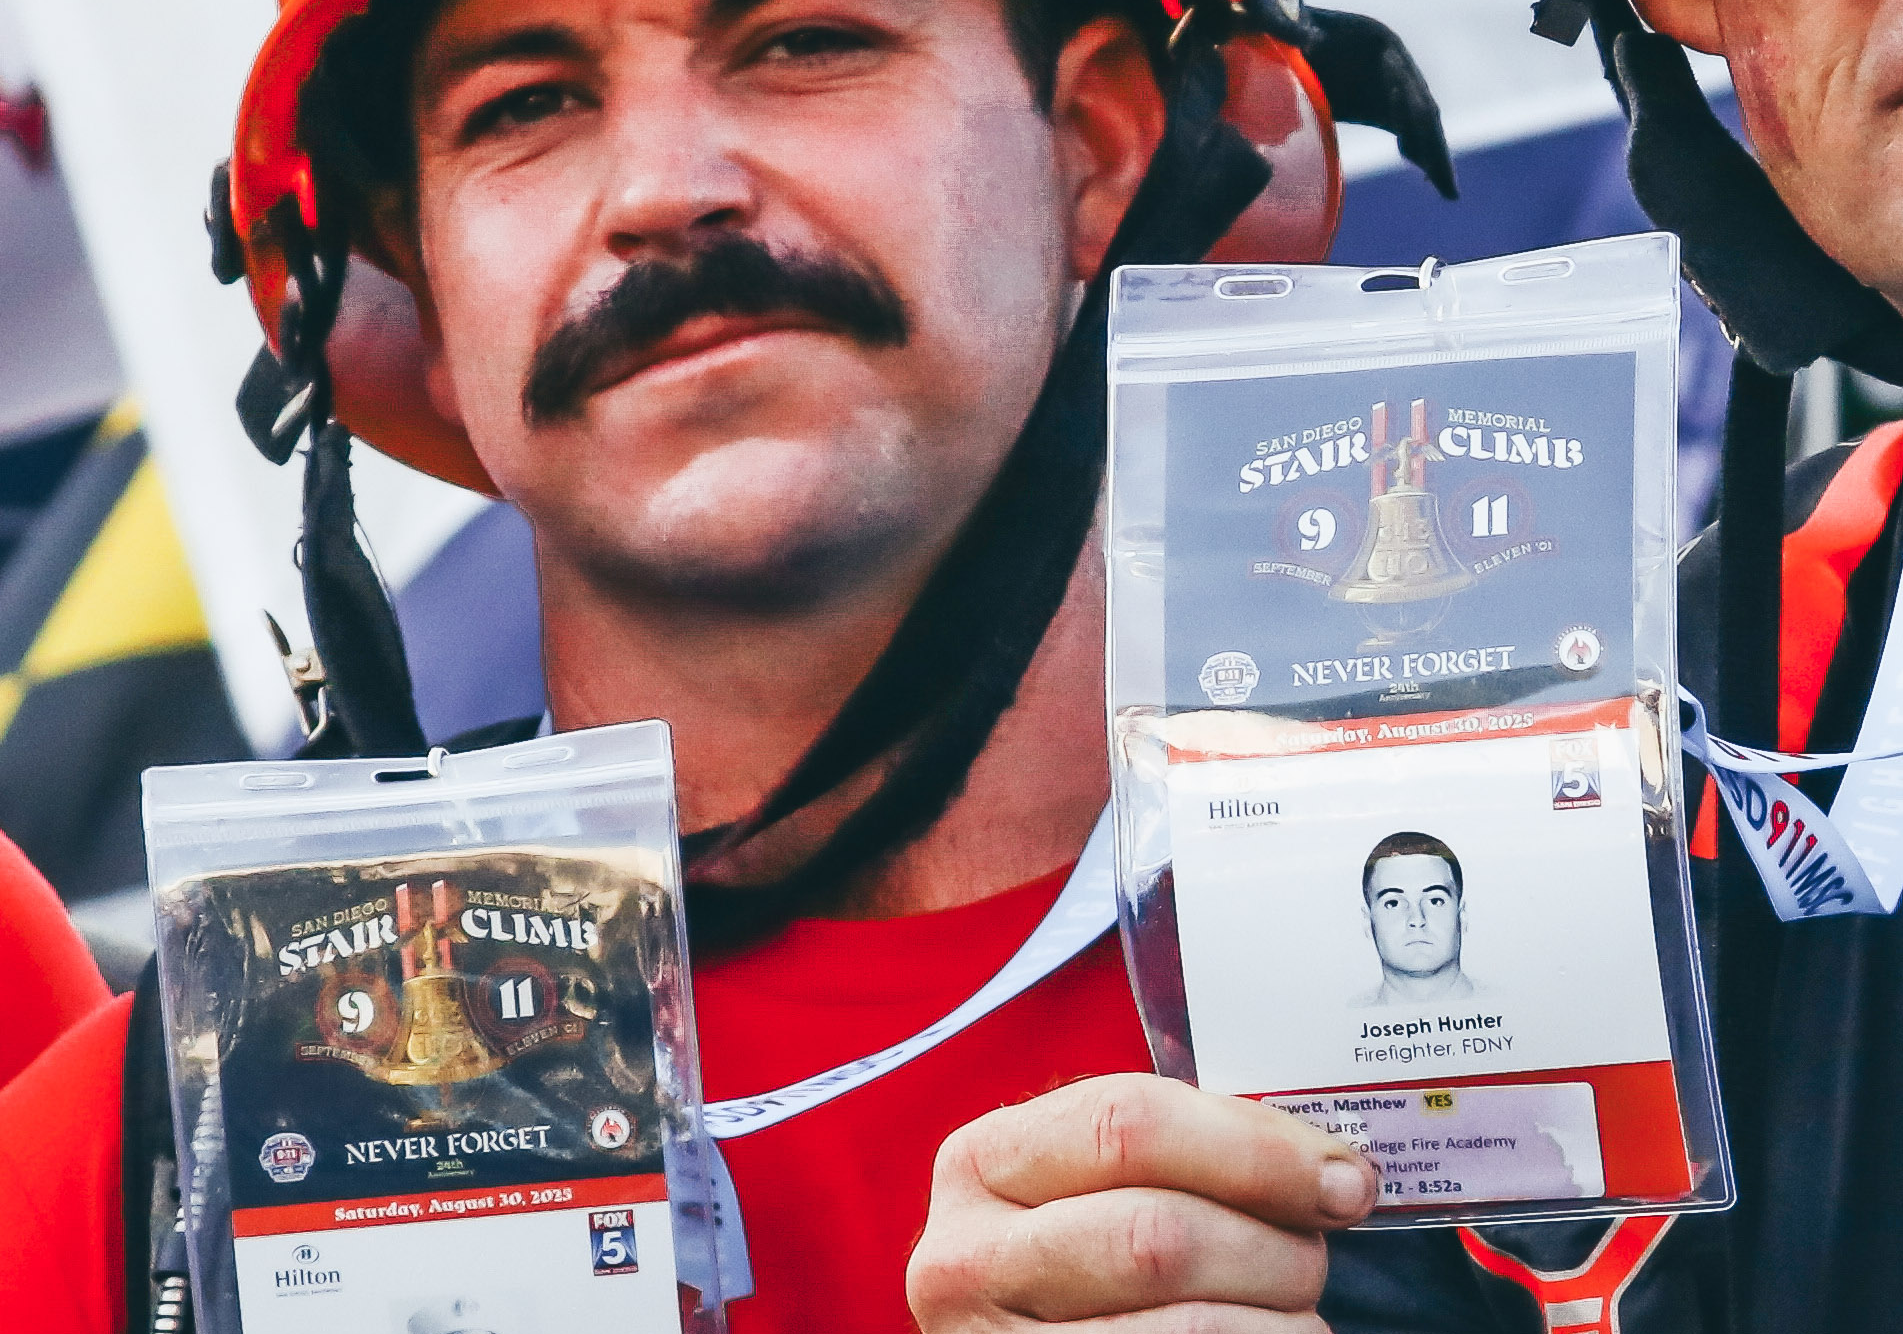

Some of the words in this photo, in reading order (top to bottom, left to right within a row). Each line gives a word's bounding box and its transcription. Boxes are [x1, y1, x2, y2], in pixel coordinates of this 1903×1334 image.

[1256, 434, 1297, 455] SAN
[1302, 416, 1363, 444] DIEGO
[1448, 408, 1552, 434] MEMORIAL
[1239, 431, 1371, 493] STAIR
[1438, 426, 1586, 469] CLIMB
[1297, 507, 1337, 551] 9
[1471, 494, 1509, 538] 11
[1252, 562, 1332, 587] SEPTEMBER
[1474, 542, 1532, 575] ELEVEN
[1291, 655, 1393, 688] NEVER
[1402, 645, 1516, 679] FORGET
[1276, 726, 1372, 751] Saturday,
[1377, 720, 1450, 742] August
[1487, 712, 1535, 731] 2025
[1561, 760, 1590, 798] 5
[1208, 796, 1281, 820] Hilton
[292, 917, 328, 938] SAN
[333, 898, 388, 926] DIEGO
[467, 889, 566, 913] MEMORI
[277, 914, 400, 977] STAIR
[461, 908, 598, 950] CLIMB
[337, 991, 375, 1035] 9
[499, 976, 535, 1019] 11
[1360, 1019, 1432, 1039] Joseph
[1438, 1013, 1504, 1033] Hunter
[1354, 1042, 1456, 1064] Firefighter,
[1462, 1035, 1514, 1055] FDNY
[1334, 1096, 1407, 1113] Matthew
[1422, 1094, 1453, 1109] YES
[345, 1135, 439, 1165] NEVER
[446, 1124, 551, 1157] FORGET
[1326, 1120, 1368, 1136] Large
[1411, 1138, 1441, 1151] Fire
[1445, 1136, 1517, 1150] Academy
[1385, 1160, 1441, 1173] Hunter
[335, 1201, 424, 1222] Saturday,
[429, 1194, 495, 1216] August
[499, 1192, 526, 1208] 30,
[530, 1186, 574, 1204] 2025
[1383, 1181, 1404, 1195] #2
[1417, 1180, 1464, 1194] 8:52a
[593, 1211, 630, 1229] FOX
[601, 1232, 627, 1265] 5
[275, 1268, 341, 1288] Hilton
